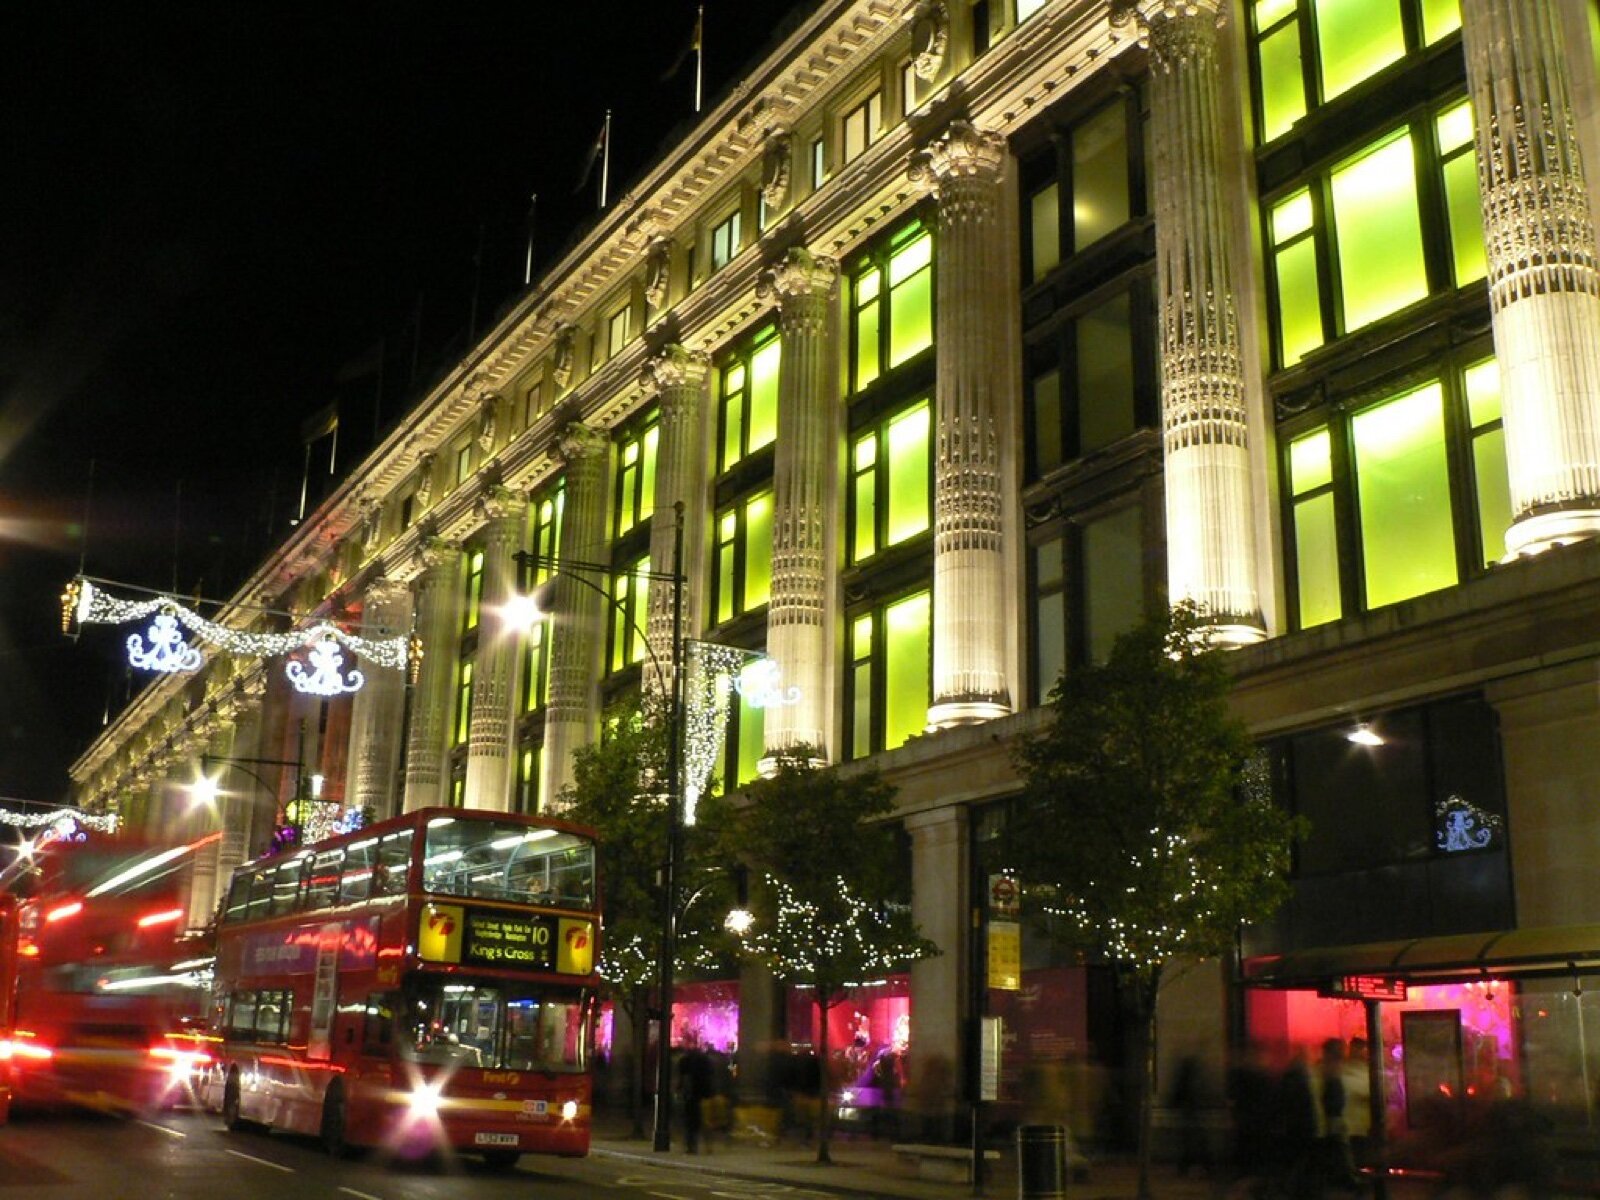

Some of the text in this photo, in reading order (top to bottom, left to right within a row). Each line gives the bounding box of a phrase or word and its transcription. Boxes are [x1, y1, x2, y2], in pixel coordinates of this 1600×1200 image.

[533, 927, 549, 945] 10
[471, 943, 535, 961] King's Cross
